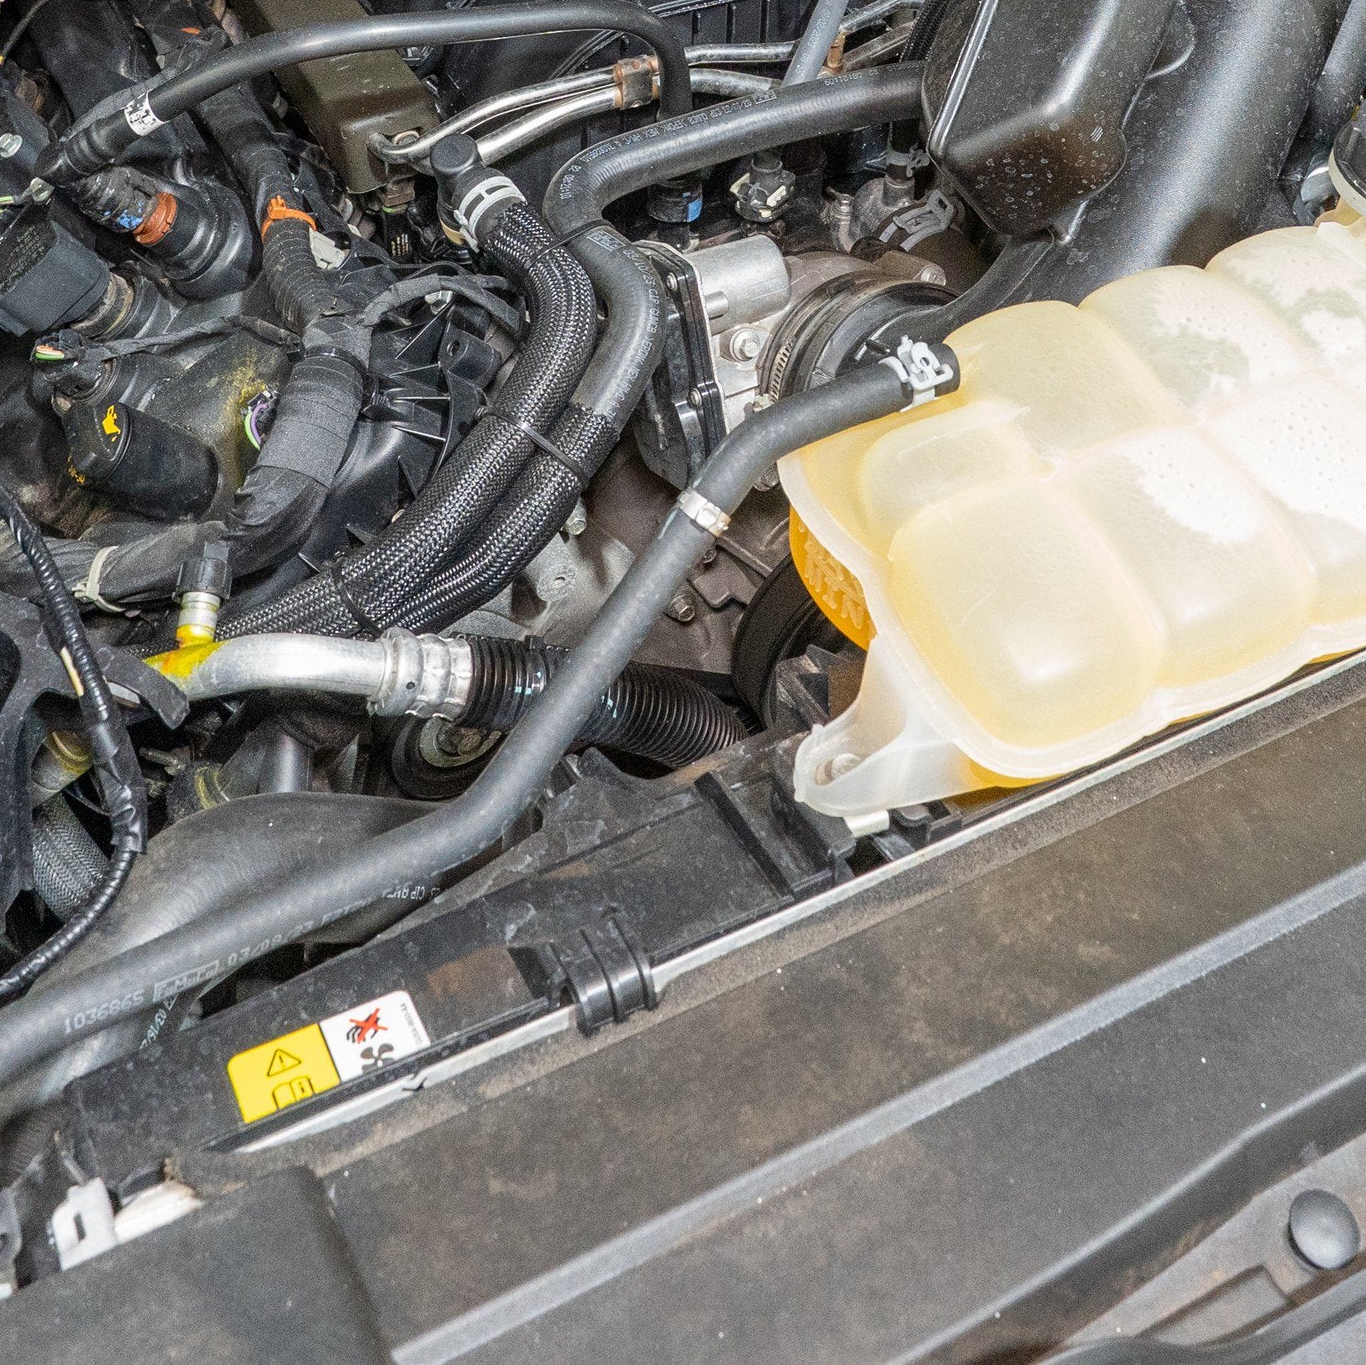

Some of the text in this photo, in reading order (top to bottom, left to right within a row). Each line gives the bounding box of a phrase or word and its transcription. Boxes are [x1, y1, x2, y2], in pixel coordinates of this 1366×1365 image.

[648, 288, 660, 310] CIP
[803, 555, 866, 630] MIN
[64, 988, 146, 1035] 1036865
